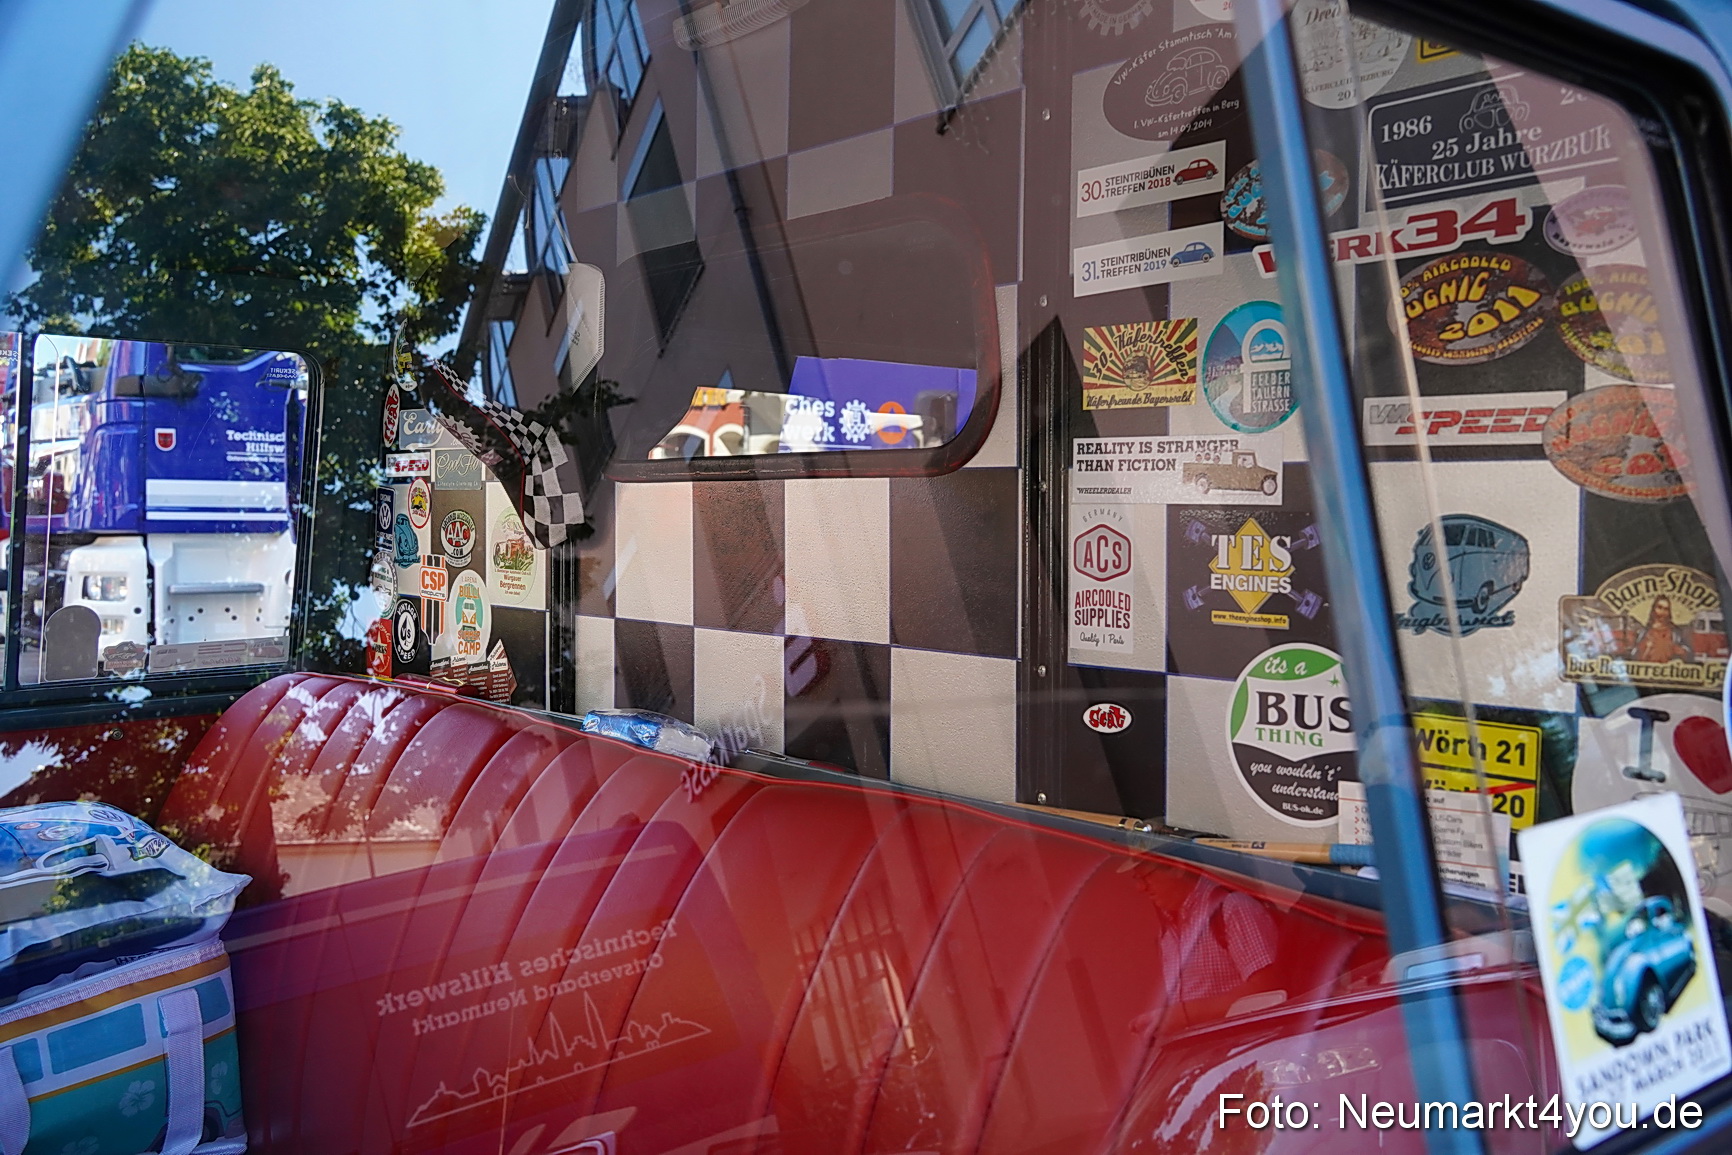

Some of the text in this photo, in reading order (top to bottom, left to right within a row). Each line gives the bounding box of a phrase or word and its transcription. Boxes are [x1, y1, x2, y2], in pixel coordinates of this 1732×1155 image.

[1158, 29, 1213, 52] Stammtisch
[1212, 104, 1220, 112] in
[1221, 99, 1240, 110] Berg
[1157, 118, 1213, 139] am 14.09.2014
[1381, 115, 1433, 144] 1986
[1431, 126, 1543, 161] 25 Jahre
[1081, 164, 1176, 203] 30. STEINTRIBÜNEN
[1374, 158, 1496, 191] KÄFERCLUB
[1104, 177, 1172, 199] TREFFEN 2018
[1081, 247, 1171, 282] 31. STEINTRIBÜNEN
[1100, 259, 1167, 279] TREFFEN 2019
[1405, 271, 1490, 319] UGNIC
[1438, 286, 1542, 341] 2011
[1114, 327, 1190, 380] Käfertreffen
[1091, 351, 1113, 381] 30.
[1251, 371, 1291, 387] FELBER
[1142, 390, 1194, 406] Bayerwald
[1251, 385, 1290, 400] TAUERN
[1251, 398, 1290, 413] STRASSE
[1076, 439, 1239, 455] REALITY IS STRANGER
[1076, 458, 1177, 473] THAN FICTION
[1076, 487, 1132, 495] WHEELERDEALER
[1082, 508, 1124, 523] GERMANY
[1083, 534, 1122, 573] ACS
[1210, 534, 1293, 572] TES
[421, 570, 446, 591] CSP
[1210, 573, 1292, 594] ENGINES
[421, 589, 446, 598] PRODUCTS
[1074, 589, 1131, 612] AIRCOOLED
[397, 603, 417, 621] VINTAGE
[1074, 608, 1131, 629] SUPPLIES
[1213, 613, 1287, 624] www.theengineshop.info
[457, 641, 481, 655] CAMP
[1079, 632, 1125, 647] Quality Parts
[397, 645, 416, 660] SPEED
[1264, 656, 1308, 676] its a
[1569, 656, 1595, 673] Bus
[1255, 690, 1355, 734] BUS
[1255, 727, 1324, 748] THING
[1415, 728, 1526, 767] Wörth 21
[1622, 707, 1671, 783] I
[1249, 761, 1273, 777] you
[1281, 802, 1324, 815] BUS-ok.de
[1493, 793, 1525, 818] 20
